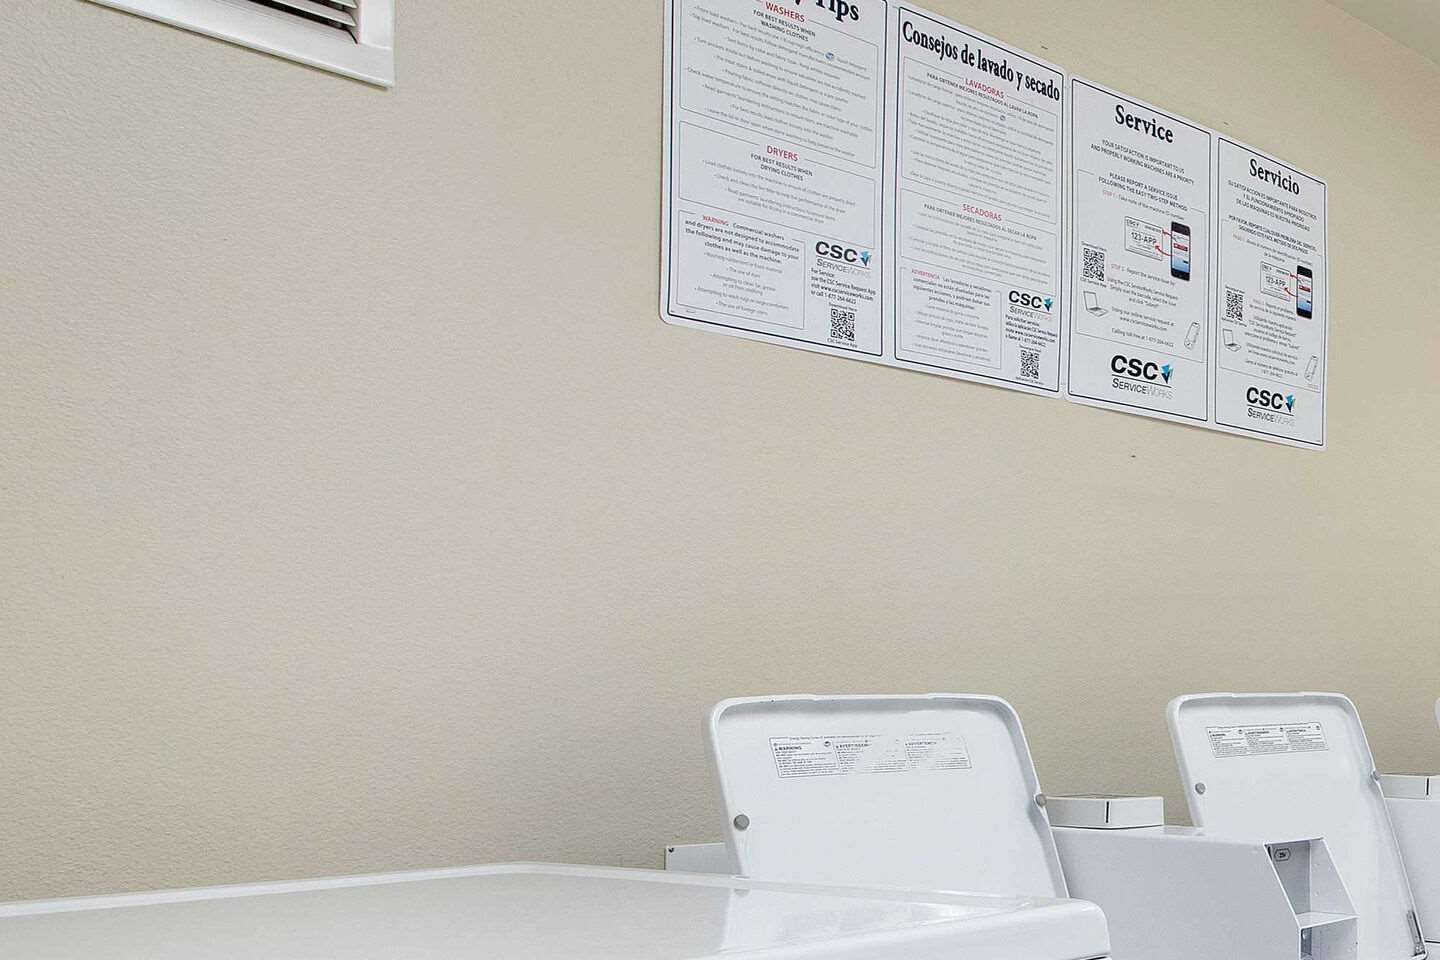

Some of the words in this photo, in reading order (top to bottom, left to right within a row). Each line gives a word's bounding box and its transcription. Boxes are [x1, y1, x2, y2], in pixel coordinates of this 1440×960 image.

[766, 2, 805, 22] WASHERS
[903, 21, 958, 60] Consejos
[961, 44, 975, 66] de
[977, 49, 1014, 82] lavado
[1016, 71, 1023, 91] y
[1025, 74, 1060, 101] secado
[965, 78, 1005, 99] LAVADORAS
[1115, 105, 1173, 143] Service
[767, 145, 799, 162] DRYERS
[1250, 159, 1300, 195] Servicio
[962, 203, 1002, 221] SECADORAS
[816, 241, 857, 262] CSC
[1009, 290, 1042, 309] CSC
[1111, 355, 1159, 380] CSC
[1246, 387, 1283, 410] CSC
